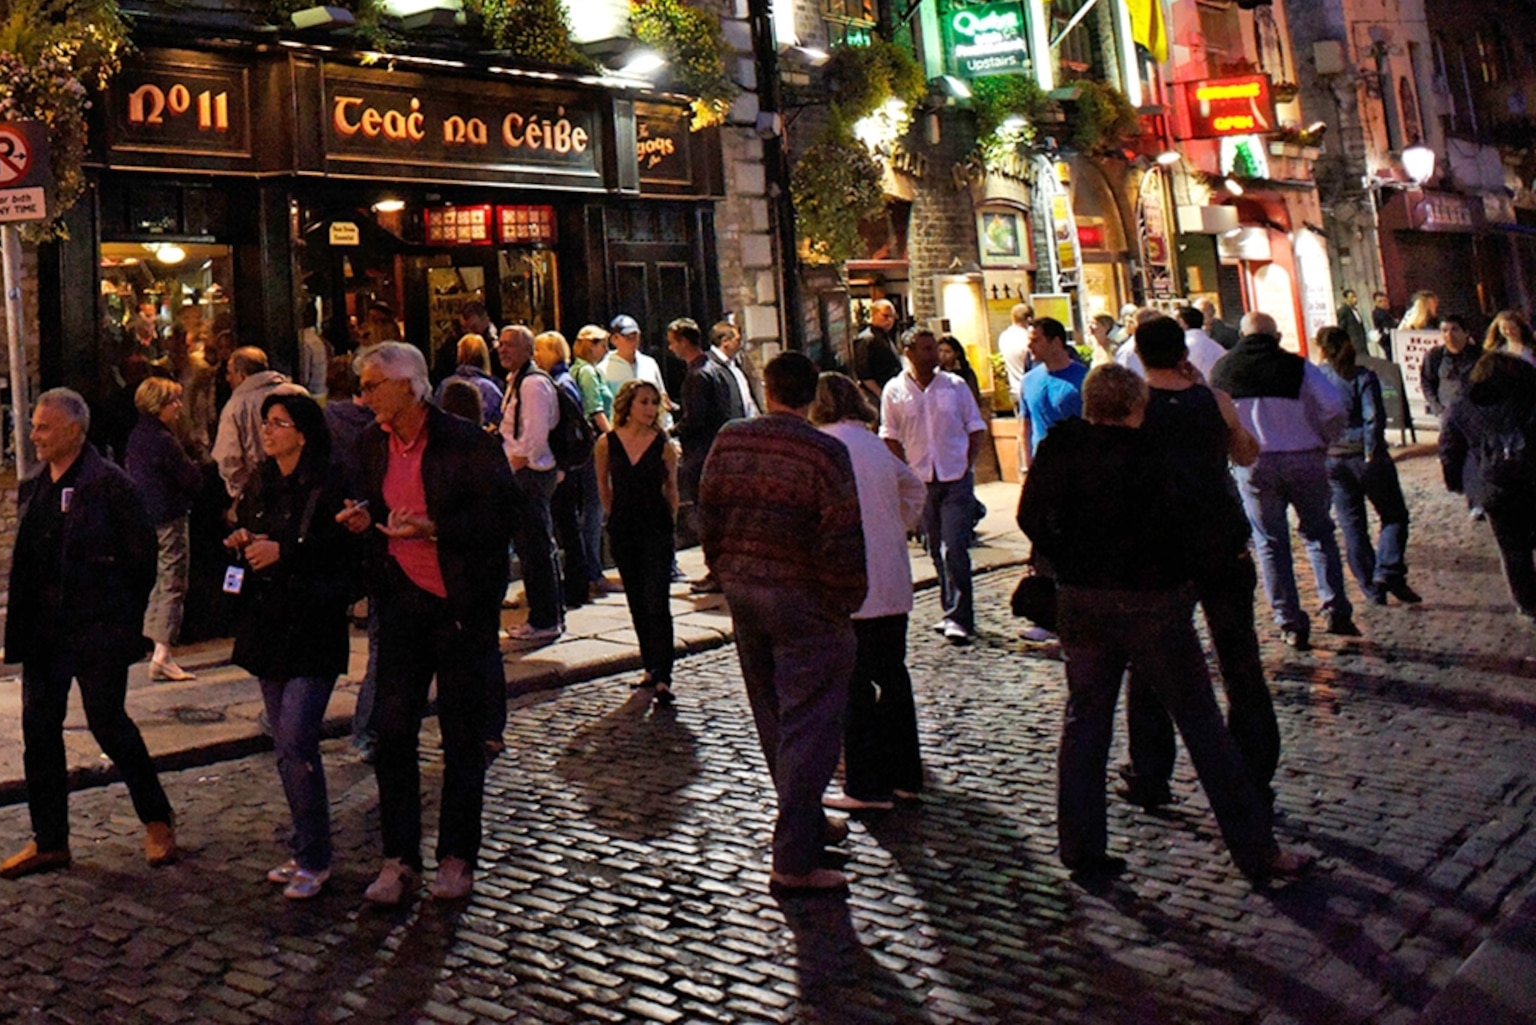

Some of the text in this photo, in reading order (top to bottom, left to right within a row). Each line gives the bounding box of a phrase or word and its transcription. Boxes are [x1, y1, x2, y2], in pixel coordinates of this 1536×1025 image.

[966, 55, 1017, 71] Upstairs
[197, 90, 229, 132] 11
[442, 114, 489, 146] na
[14, 204, 37, 213] TIME
